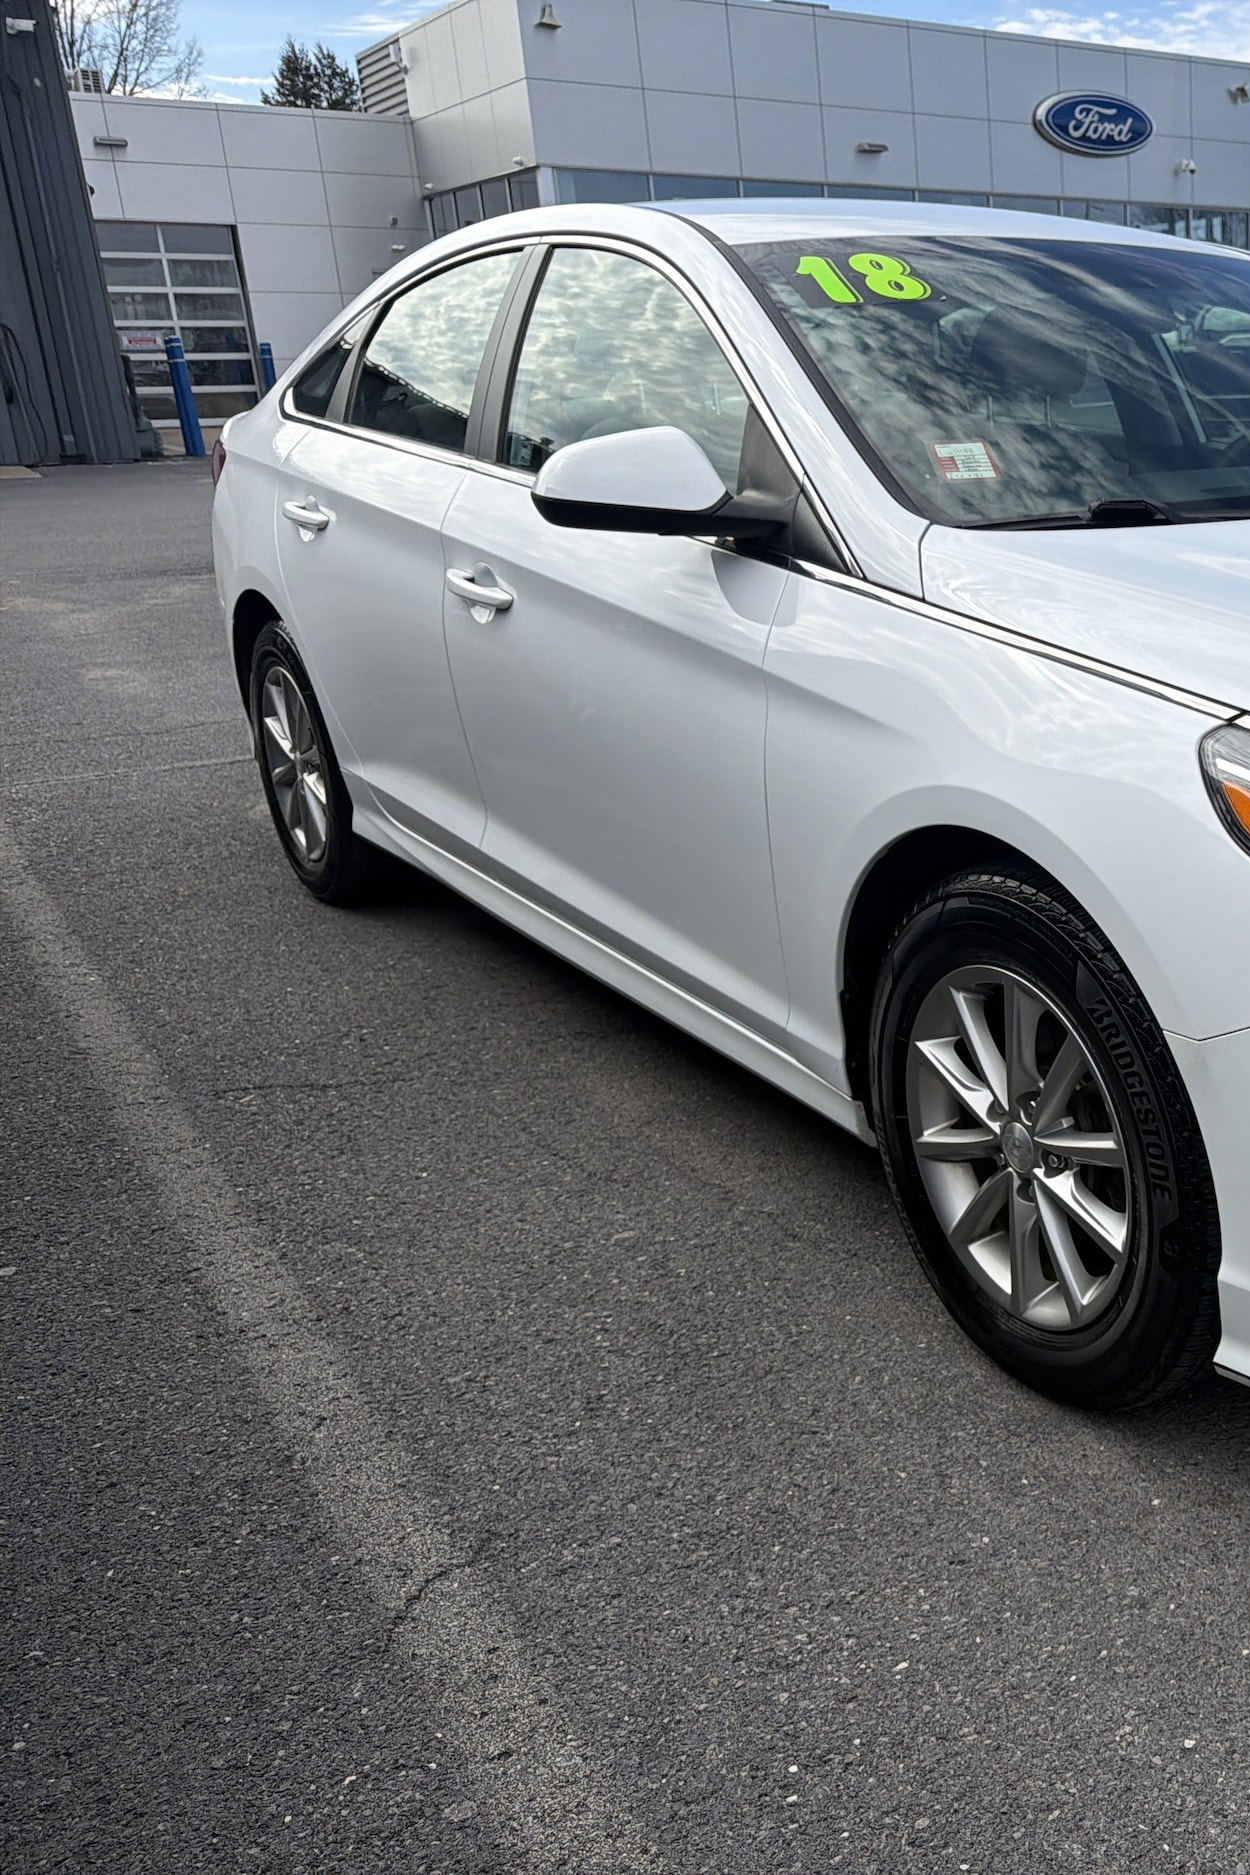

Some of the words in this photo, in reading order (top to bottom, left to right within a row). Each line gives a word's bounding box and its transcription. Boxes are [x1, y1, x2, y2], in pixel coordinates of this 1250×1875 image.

[1068, 104, 1133, 142] Ford
[796, 252, 932, 304] 18
[1087, 999, 1170, 1200] BRIDGESTONE
